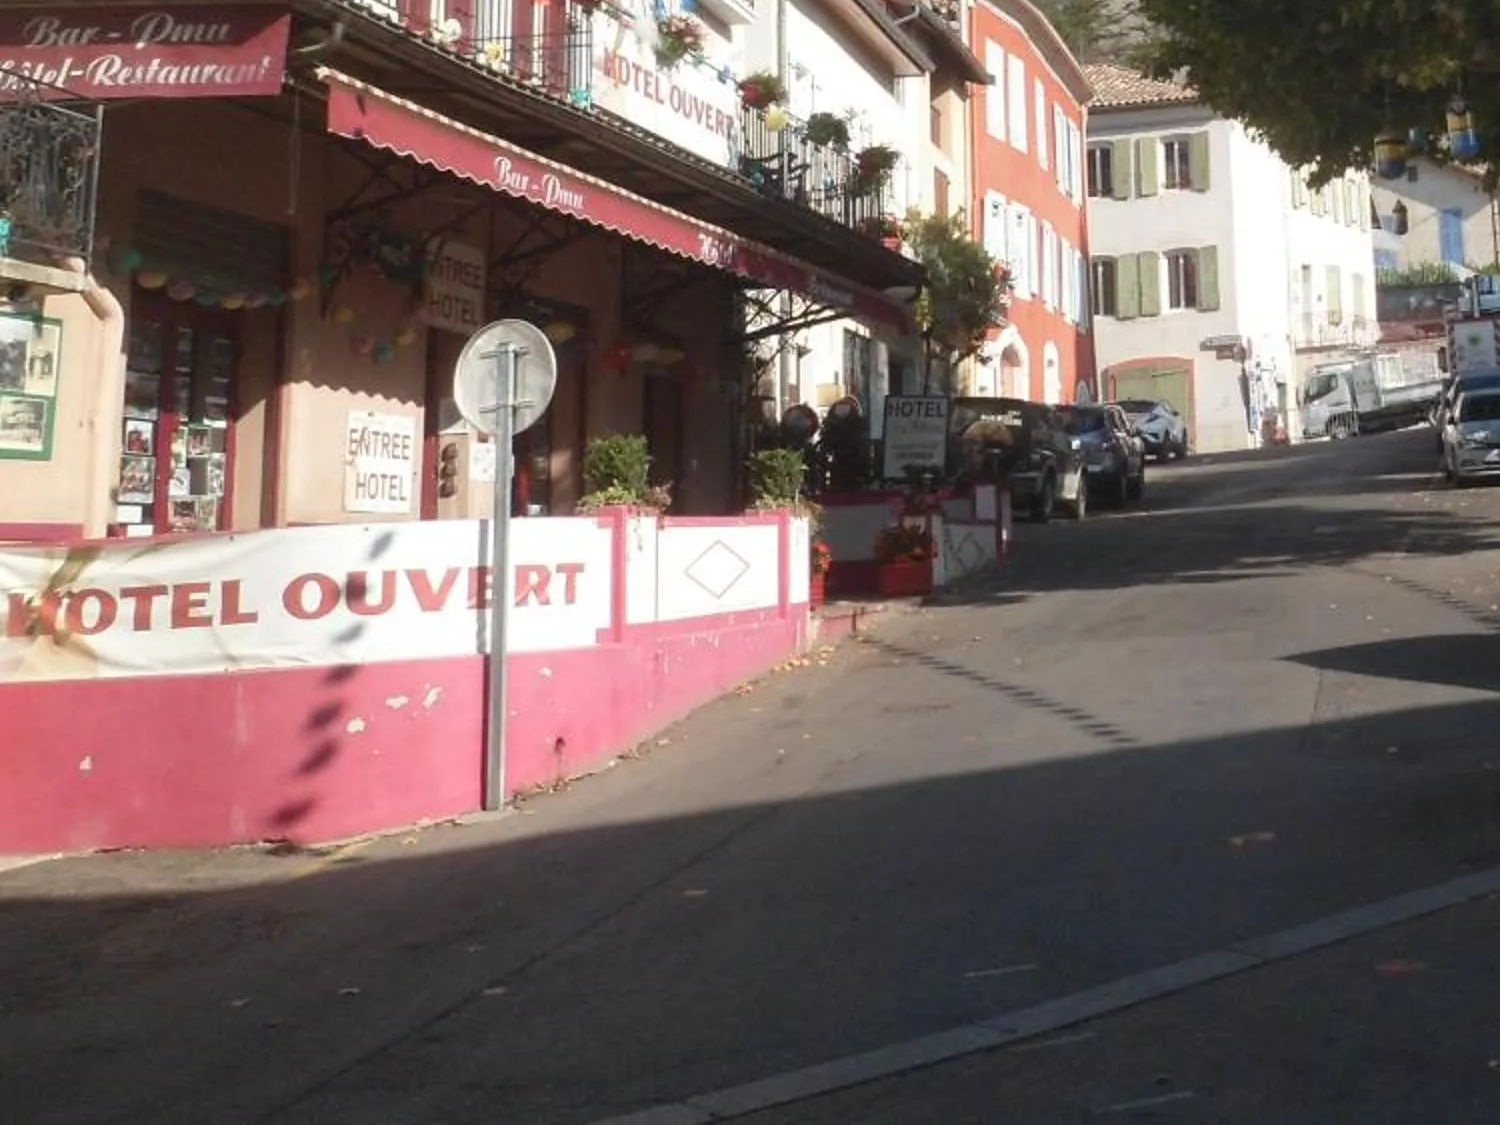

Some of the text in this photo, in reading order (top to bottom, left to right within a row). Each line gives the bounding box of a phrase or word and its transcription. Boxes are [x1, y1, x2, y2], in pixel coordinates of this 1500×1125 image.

[22, 16, 99, 49] Bar
[131, 11, 232, 50] Pmu
[602, 46, 665, 106] HOTEL
[429, 290, 480, 326] HOTEL
[888, 401, 945, 418] HOTEL
[349, 427, 411, 461] ENTREE
[355, 472, 407, 502] HOTEL
[6, 562, 586, 638] HOTEL OUVERT
